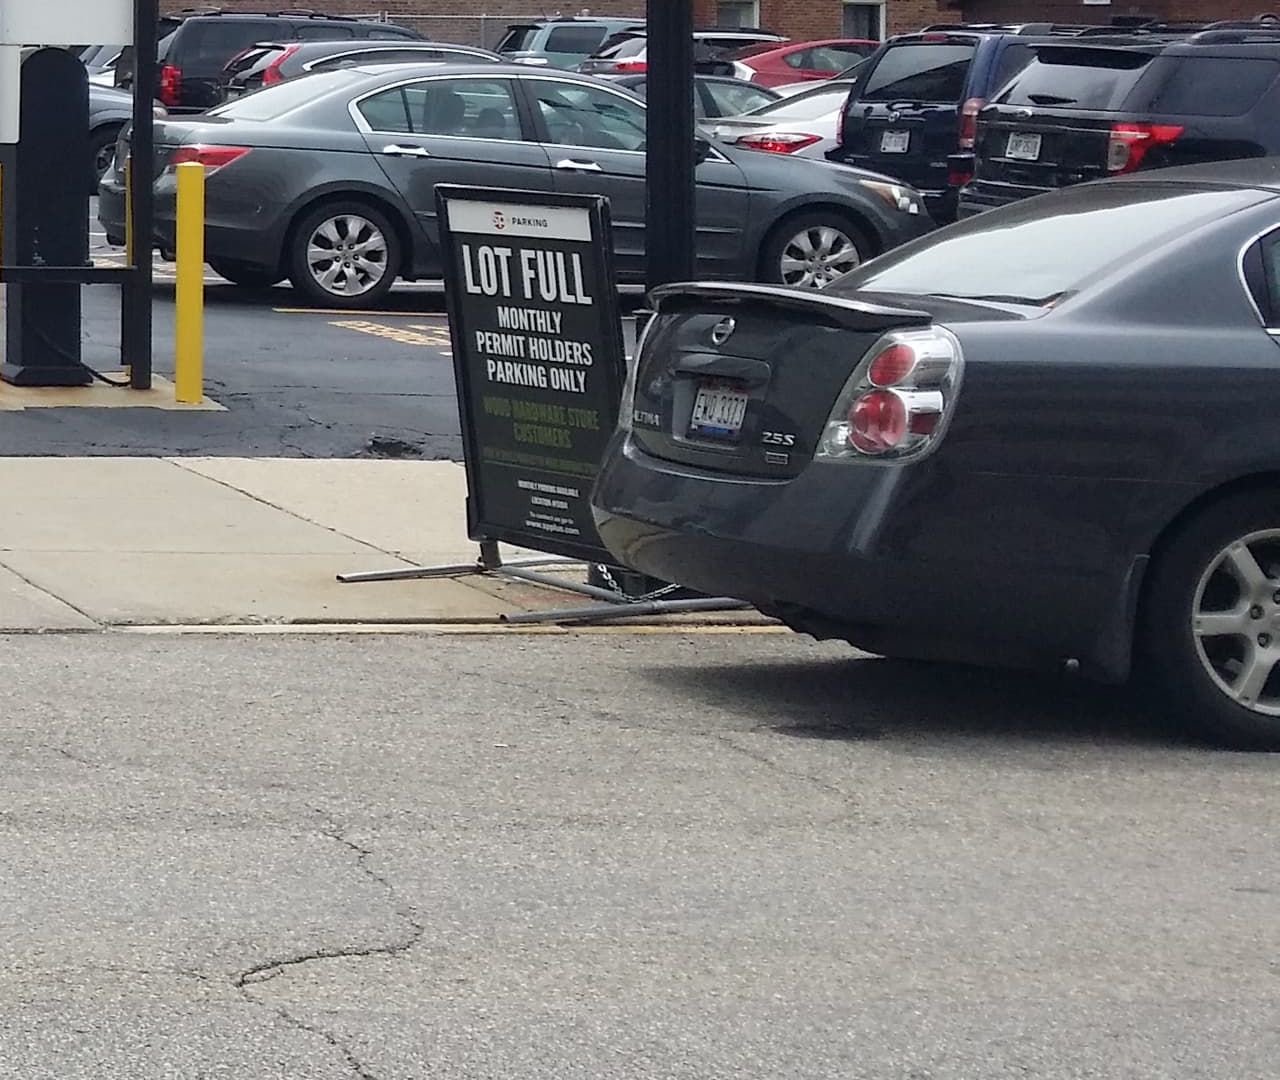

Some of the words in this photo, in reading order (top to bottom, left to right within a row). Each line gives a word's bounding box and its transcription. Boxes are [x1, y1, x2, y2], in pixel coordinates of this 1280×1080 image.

[512, 217, 548, 228] PARKING
[462, 244, 512, 297] LOT
[520, 249, 592, 304] FULL
[497, 306, 561, 334] MONTHLY
[476, 331, 525, 358] PERMIT
[528, 337, 592, 366] HOLDERS
[487, 359, 547, 388] PARKING
[550, 367, 586, 393] ONLY
